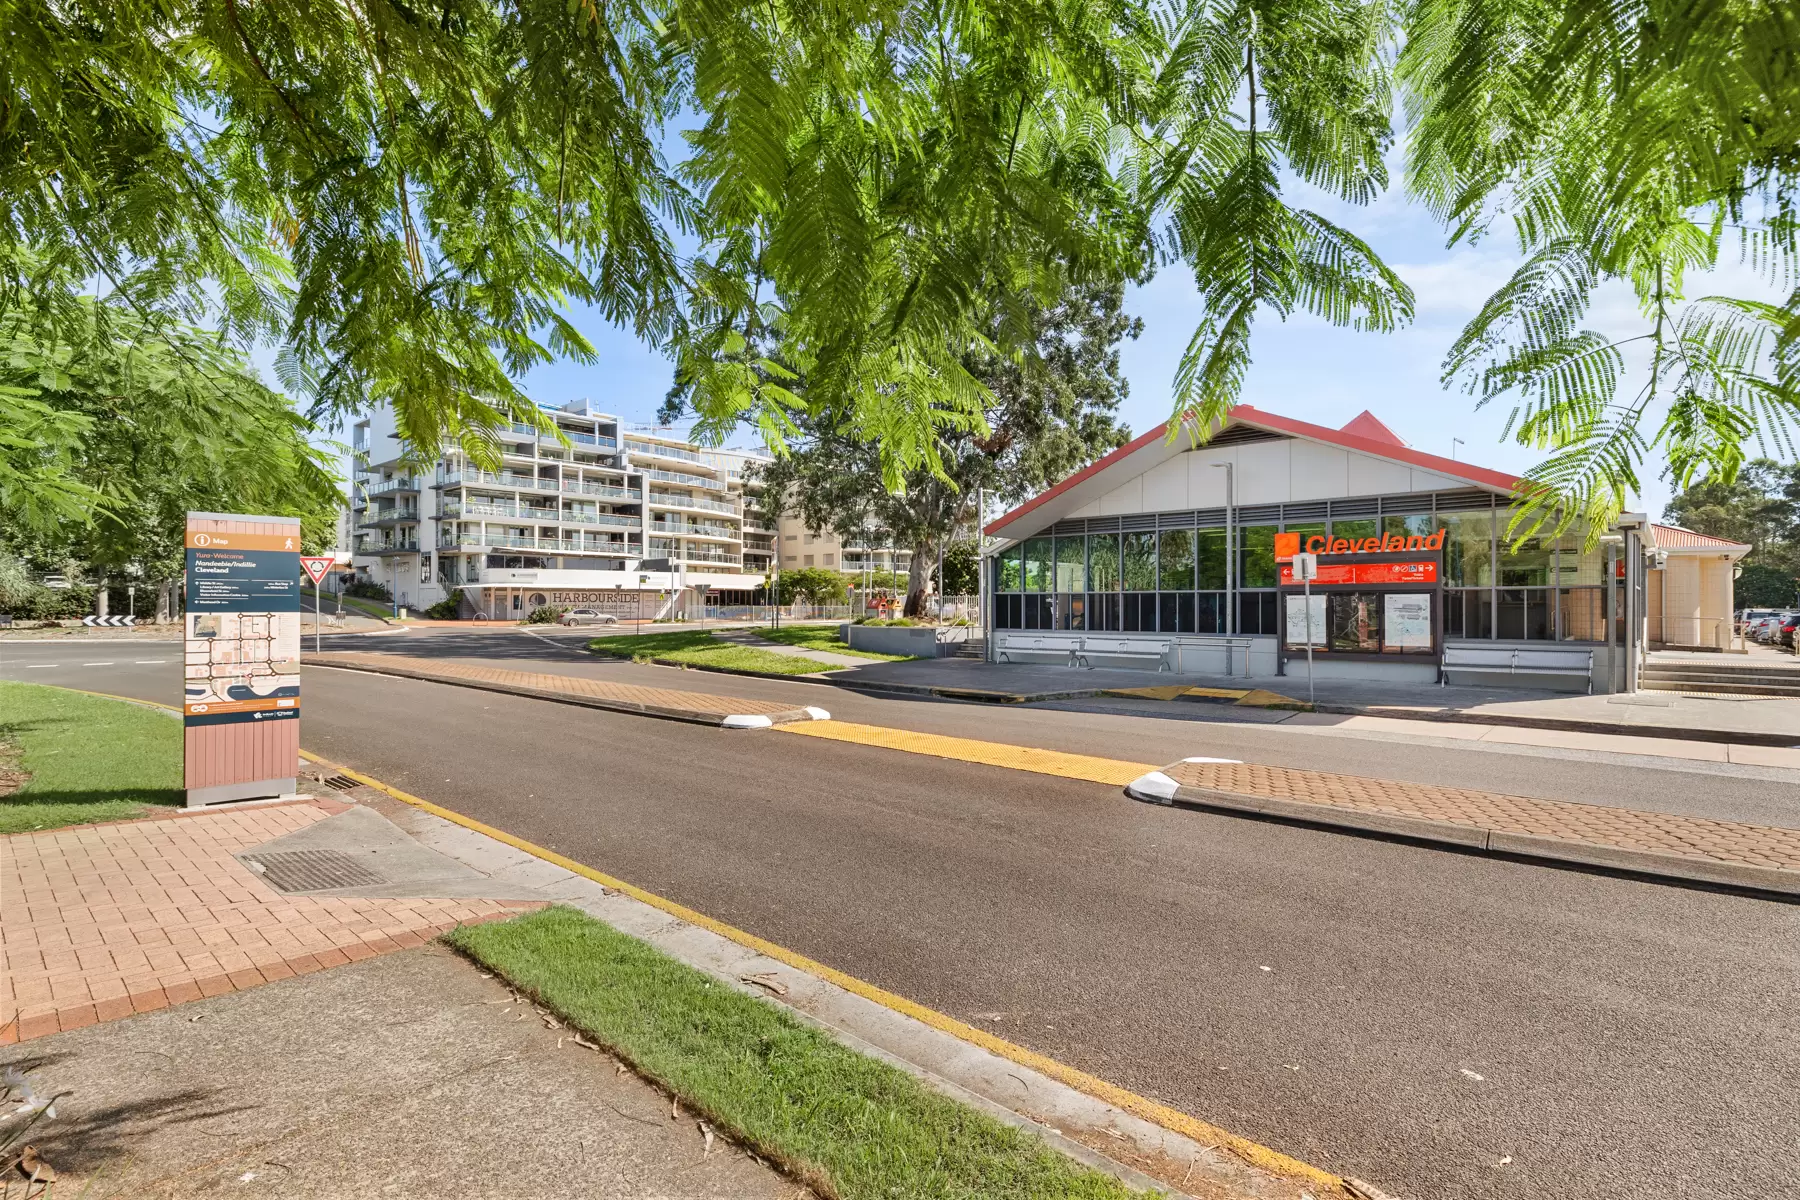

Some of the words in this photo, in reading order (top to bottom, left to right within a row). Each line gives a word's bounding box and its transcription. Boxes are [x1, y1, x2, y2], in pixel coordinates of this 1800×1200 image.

[212, 537, 228, 546] Map
[1305, 528, 1446, 555] Cleveland
[552, 592, 639, 603] HARBOURSIDE
